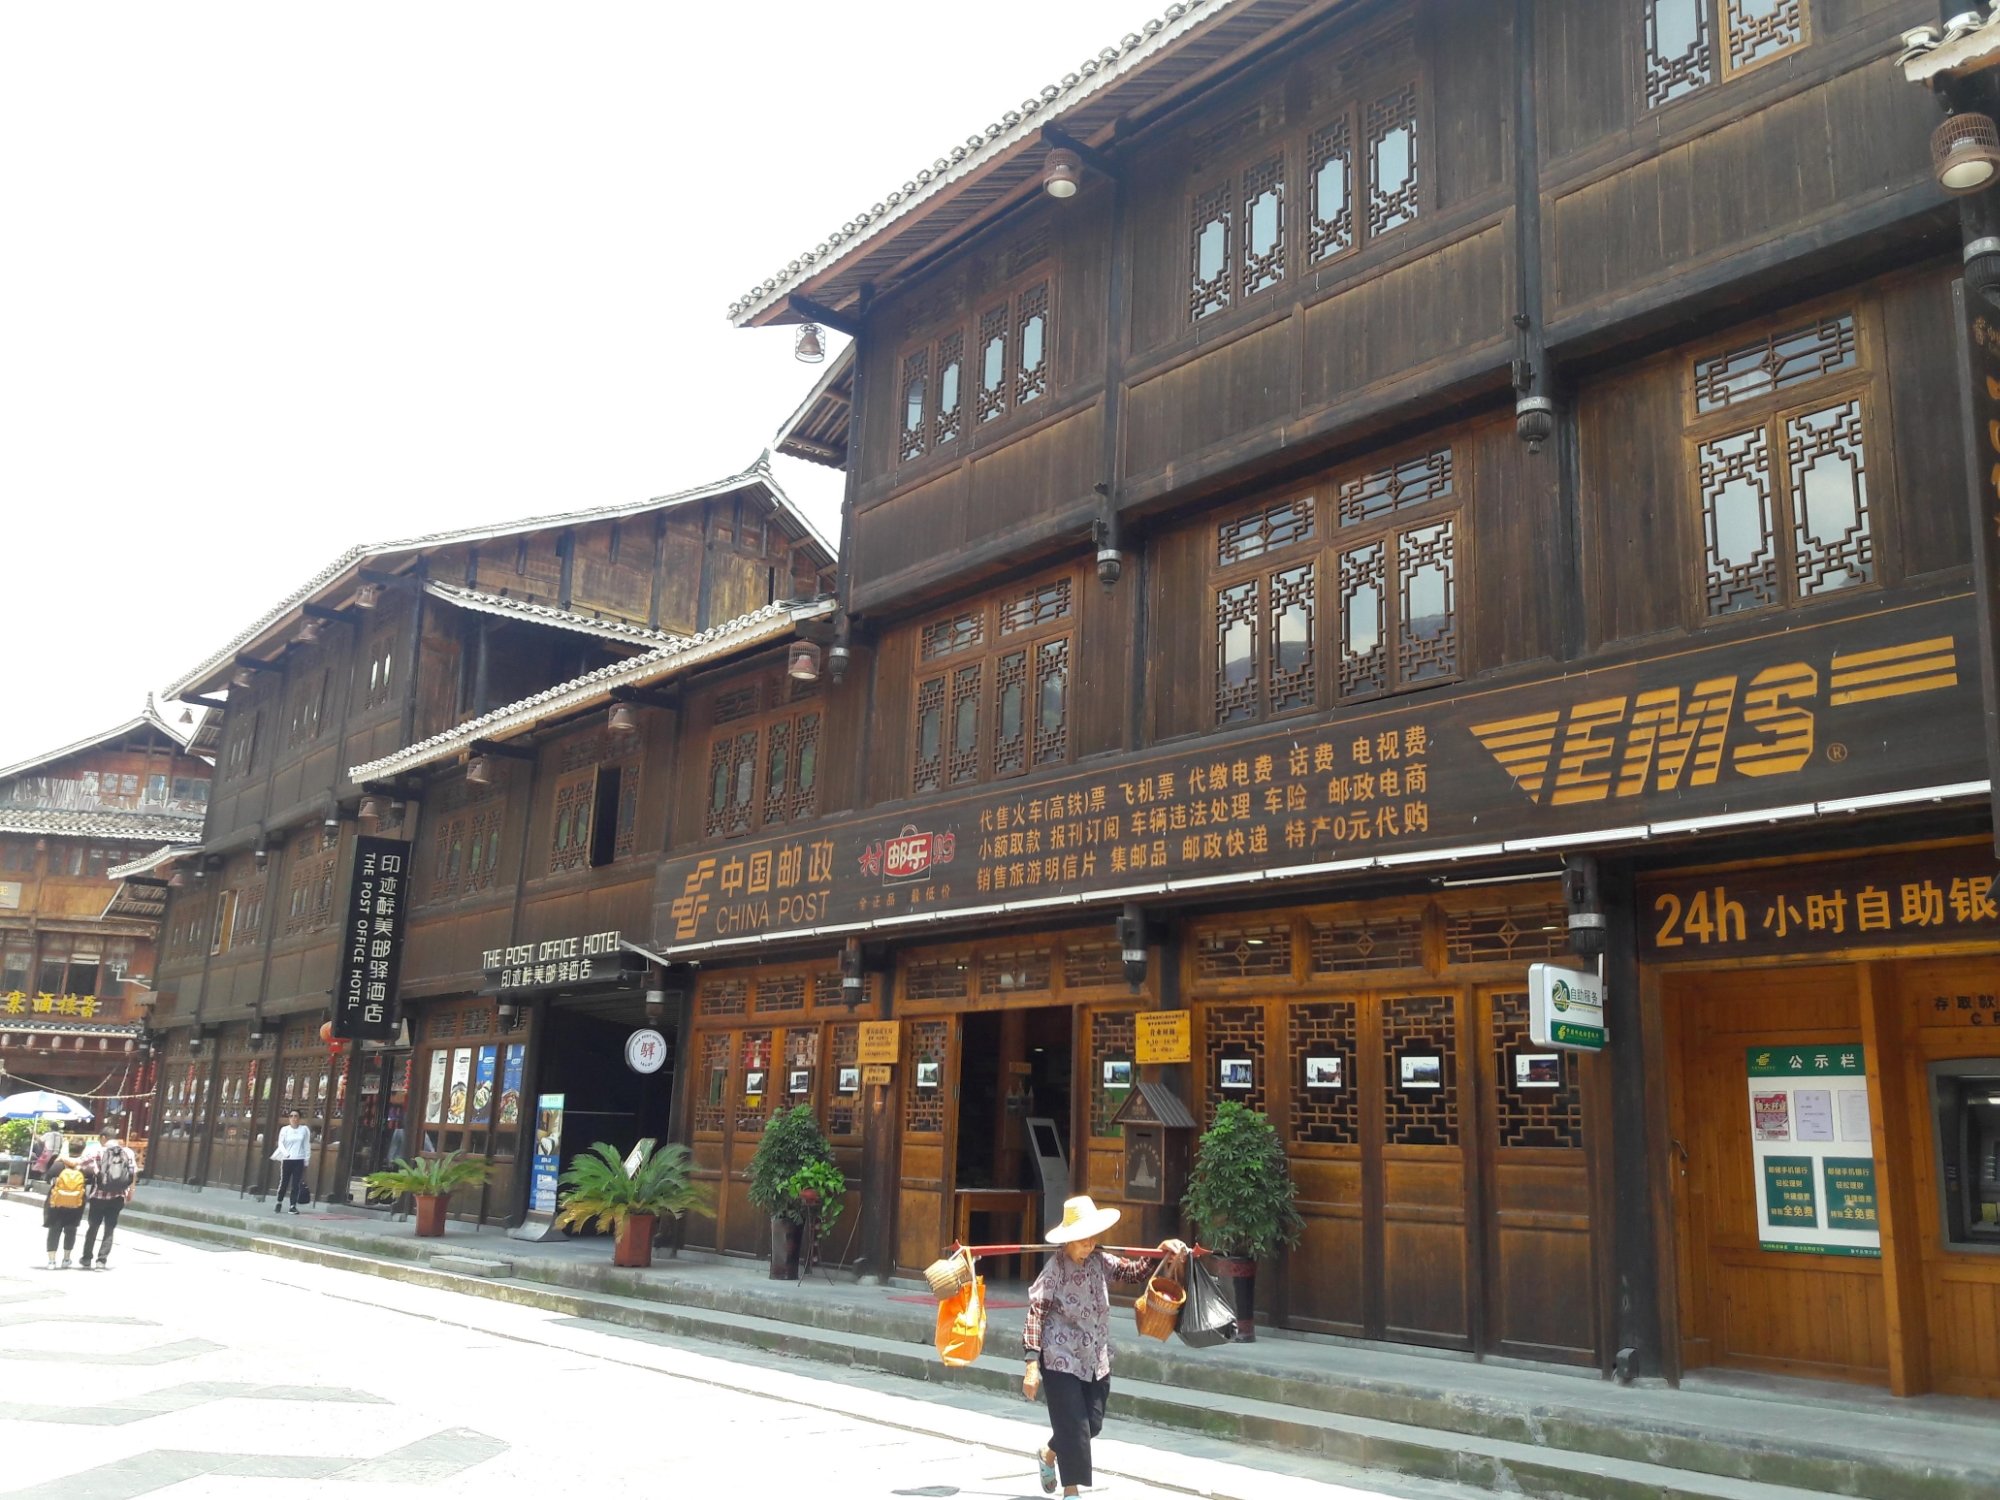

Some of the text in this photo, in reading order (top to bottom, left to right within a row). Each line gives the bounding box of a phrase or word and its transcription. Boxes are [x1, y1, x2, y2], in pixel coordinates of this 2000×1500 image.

[1551, 661, 1818, 806] EMS
[978, 763, 1428, 861] 小额取款 报刊订阅 车辆违法处理 车险 邮政电商
[979, 725, 1427, 832] 代售火车(高铁)票 飞机票 代缴电费 话费 电视费
[720, 838, 835, 898] 中国邮政
[976, 800, 1428, 892] 销售旅游明信片 集邮品 邮政快递 特产0元代购
[348, 852, 376, 1010] THE POST OFFICE HOTEL
[482, 931, 621, 970] THE POST OFFICE HOTEL
[716, 889, 831, 934] CHINA POST
[1653, 876, 1998, 948] 24h 小时自助银
[1789, 1054, 1856, 1069] 公示栏
